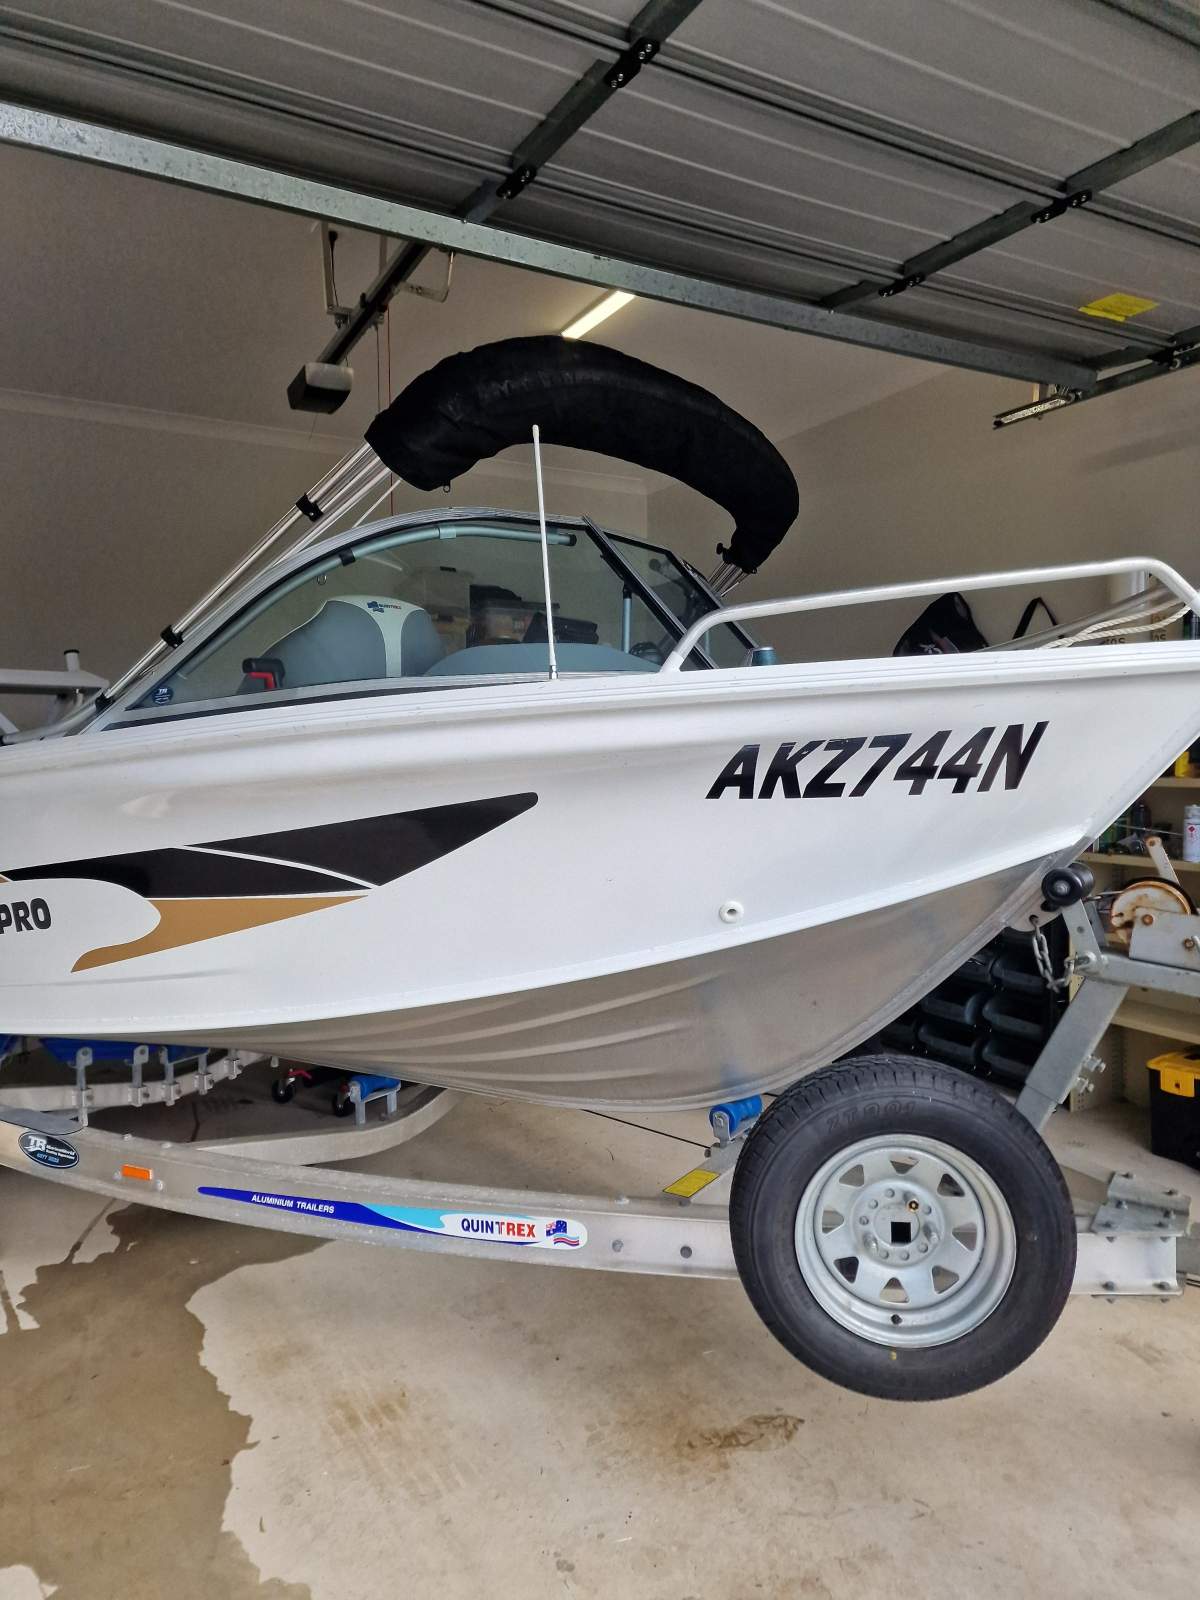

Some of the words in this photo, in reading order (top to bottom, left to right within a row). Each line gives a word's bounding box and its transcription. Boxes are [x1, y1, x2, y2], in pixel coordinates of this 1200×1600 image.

[705, 721, 1050, 799] AKZ744N
[0, 898, 52, 934] PRO
[251, 1194, 293, 1208] ALUMINIUM
[296, 1201, 335, 1214] TRAILERS
[461, 1218, 536, 1238] QUINTREX
